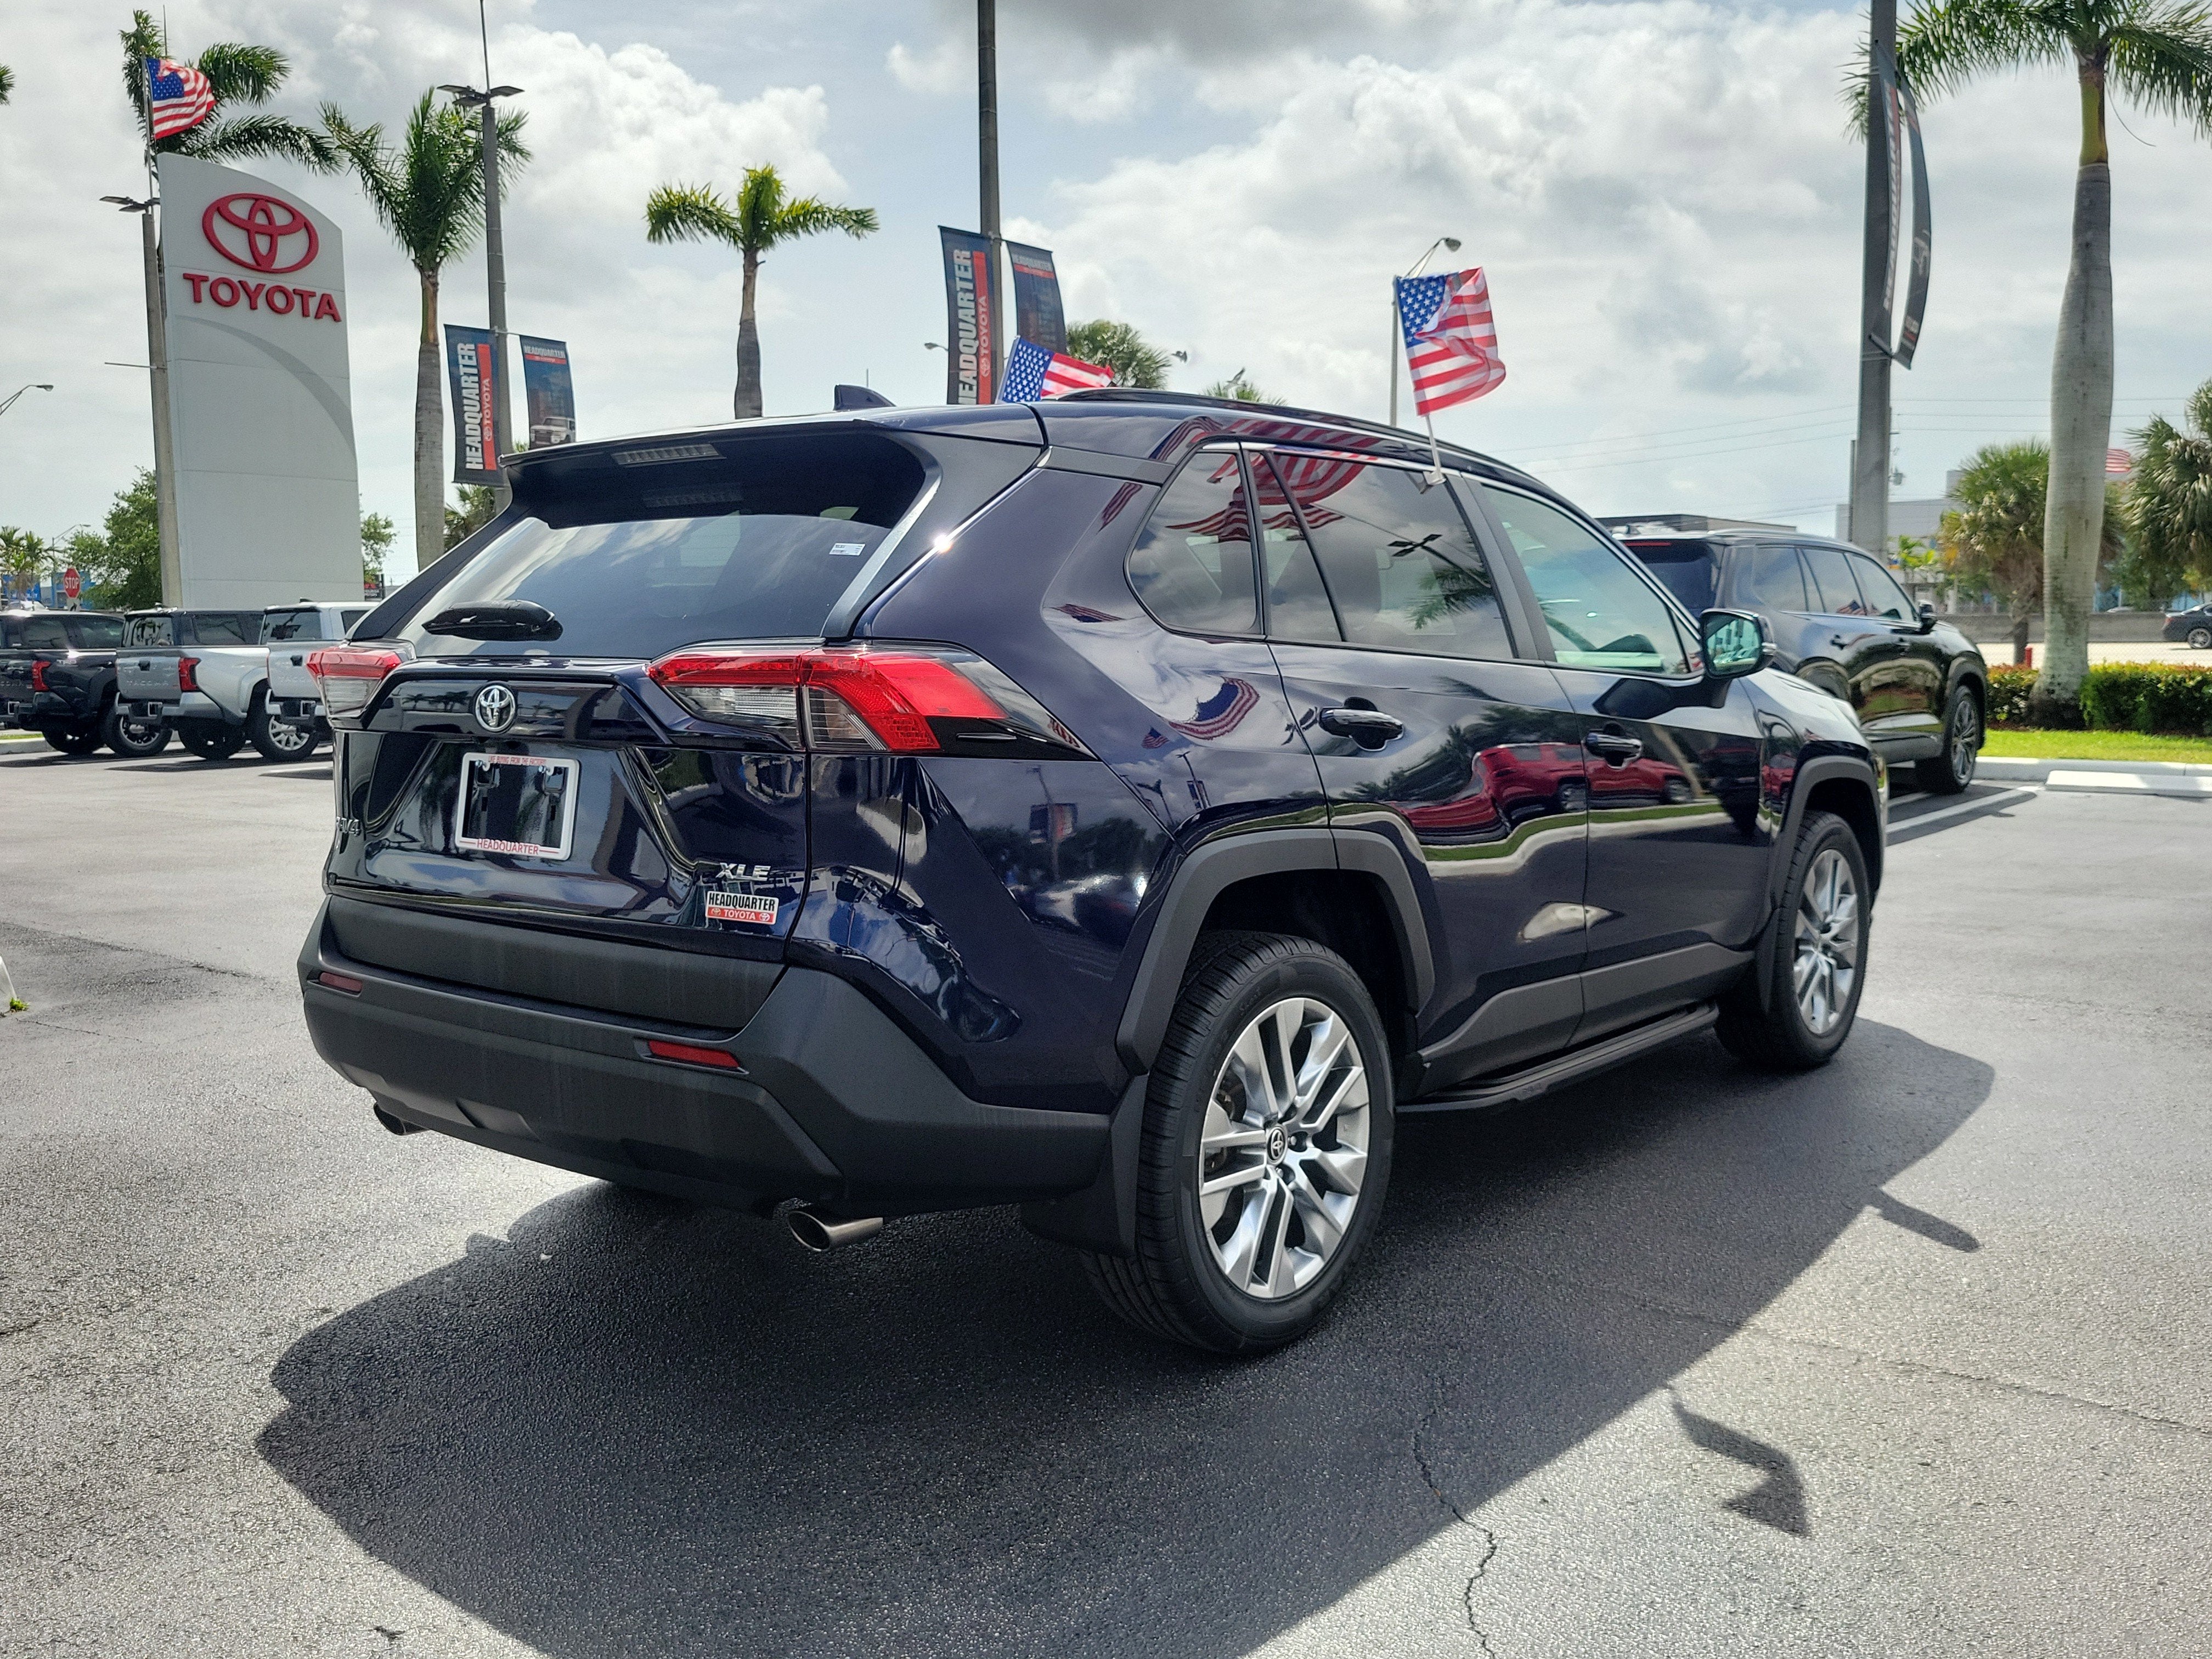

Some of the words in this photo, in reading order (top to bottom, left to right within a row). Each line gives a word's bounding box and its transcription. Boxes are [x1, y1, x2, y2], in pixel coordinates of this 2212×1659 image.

[183, 273, 342, 322] TOYOTA
[978, 295, 990, 356] TOYOTA
[457, 342, 484, 470] HEADQUARTER
[481, 378, 492, 425] TOYOTA
[65, 577, 79, 589] STOP
[477, 838, 539, 855] HEADQUARTER
[715, 862, 771, 881] XLE
[708, 892, 776, 911] HEADQUARTER
[724, 909, 756, 921] TOYOTA
